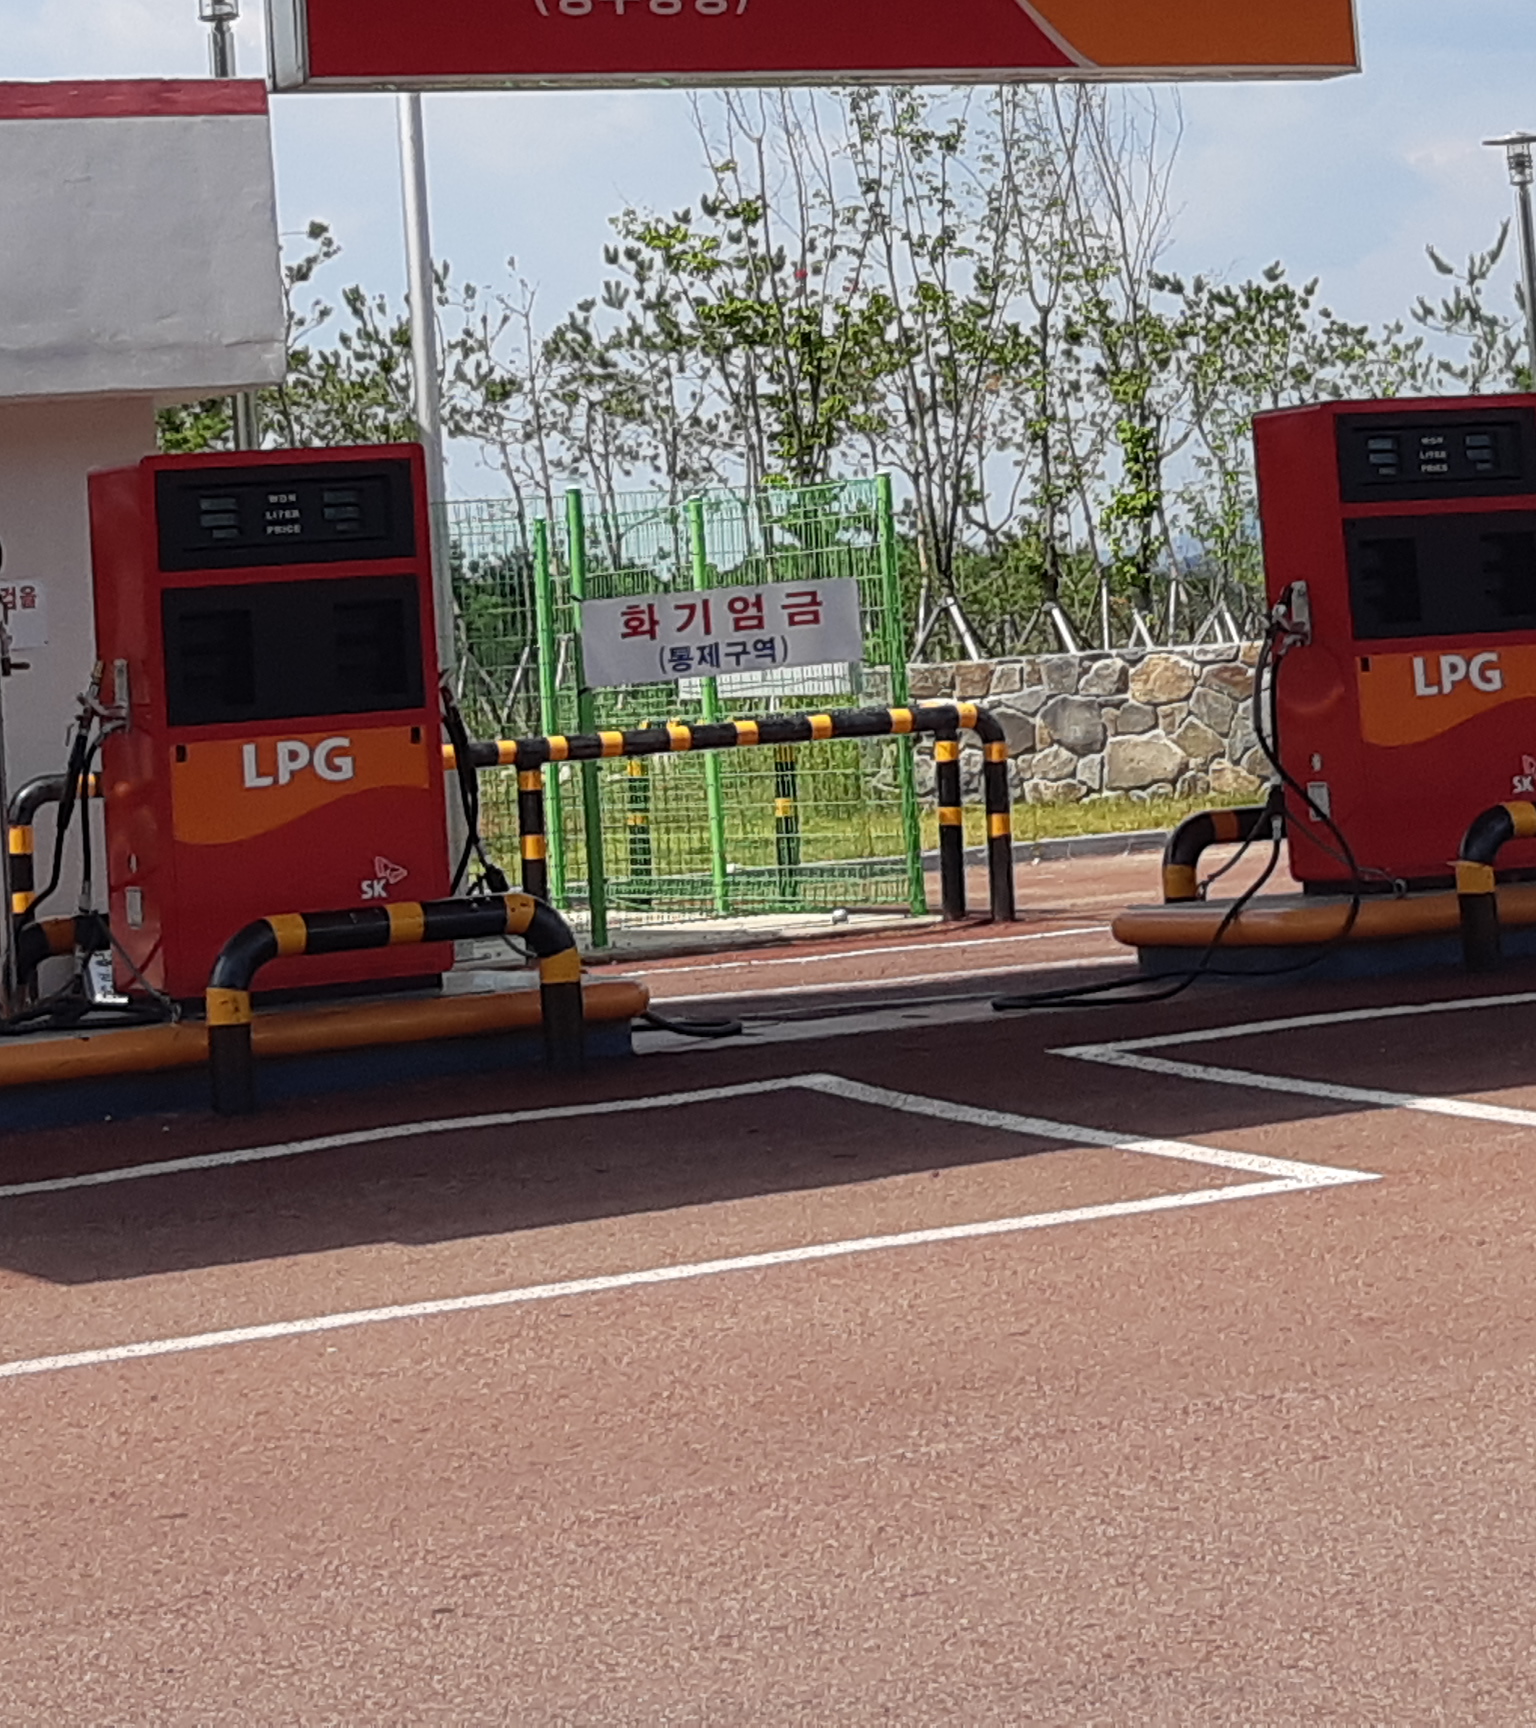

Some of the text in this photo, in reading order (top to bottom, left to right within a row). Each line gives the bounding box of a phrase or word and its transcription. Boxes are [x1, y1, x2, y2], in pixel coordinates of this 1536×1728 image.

[658, 635, 790, 673] (통제구역)
[1412, 652, 1503, 696] LPG
[241, 737, 355, 788] LPG
[361, 879, 389, 899] SK
